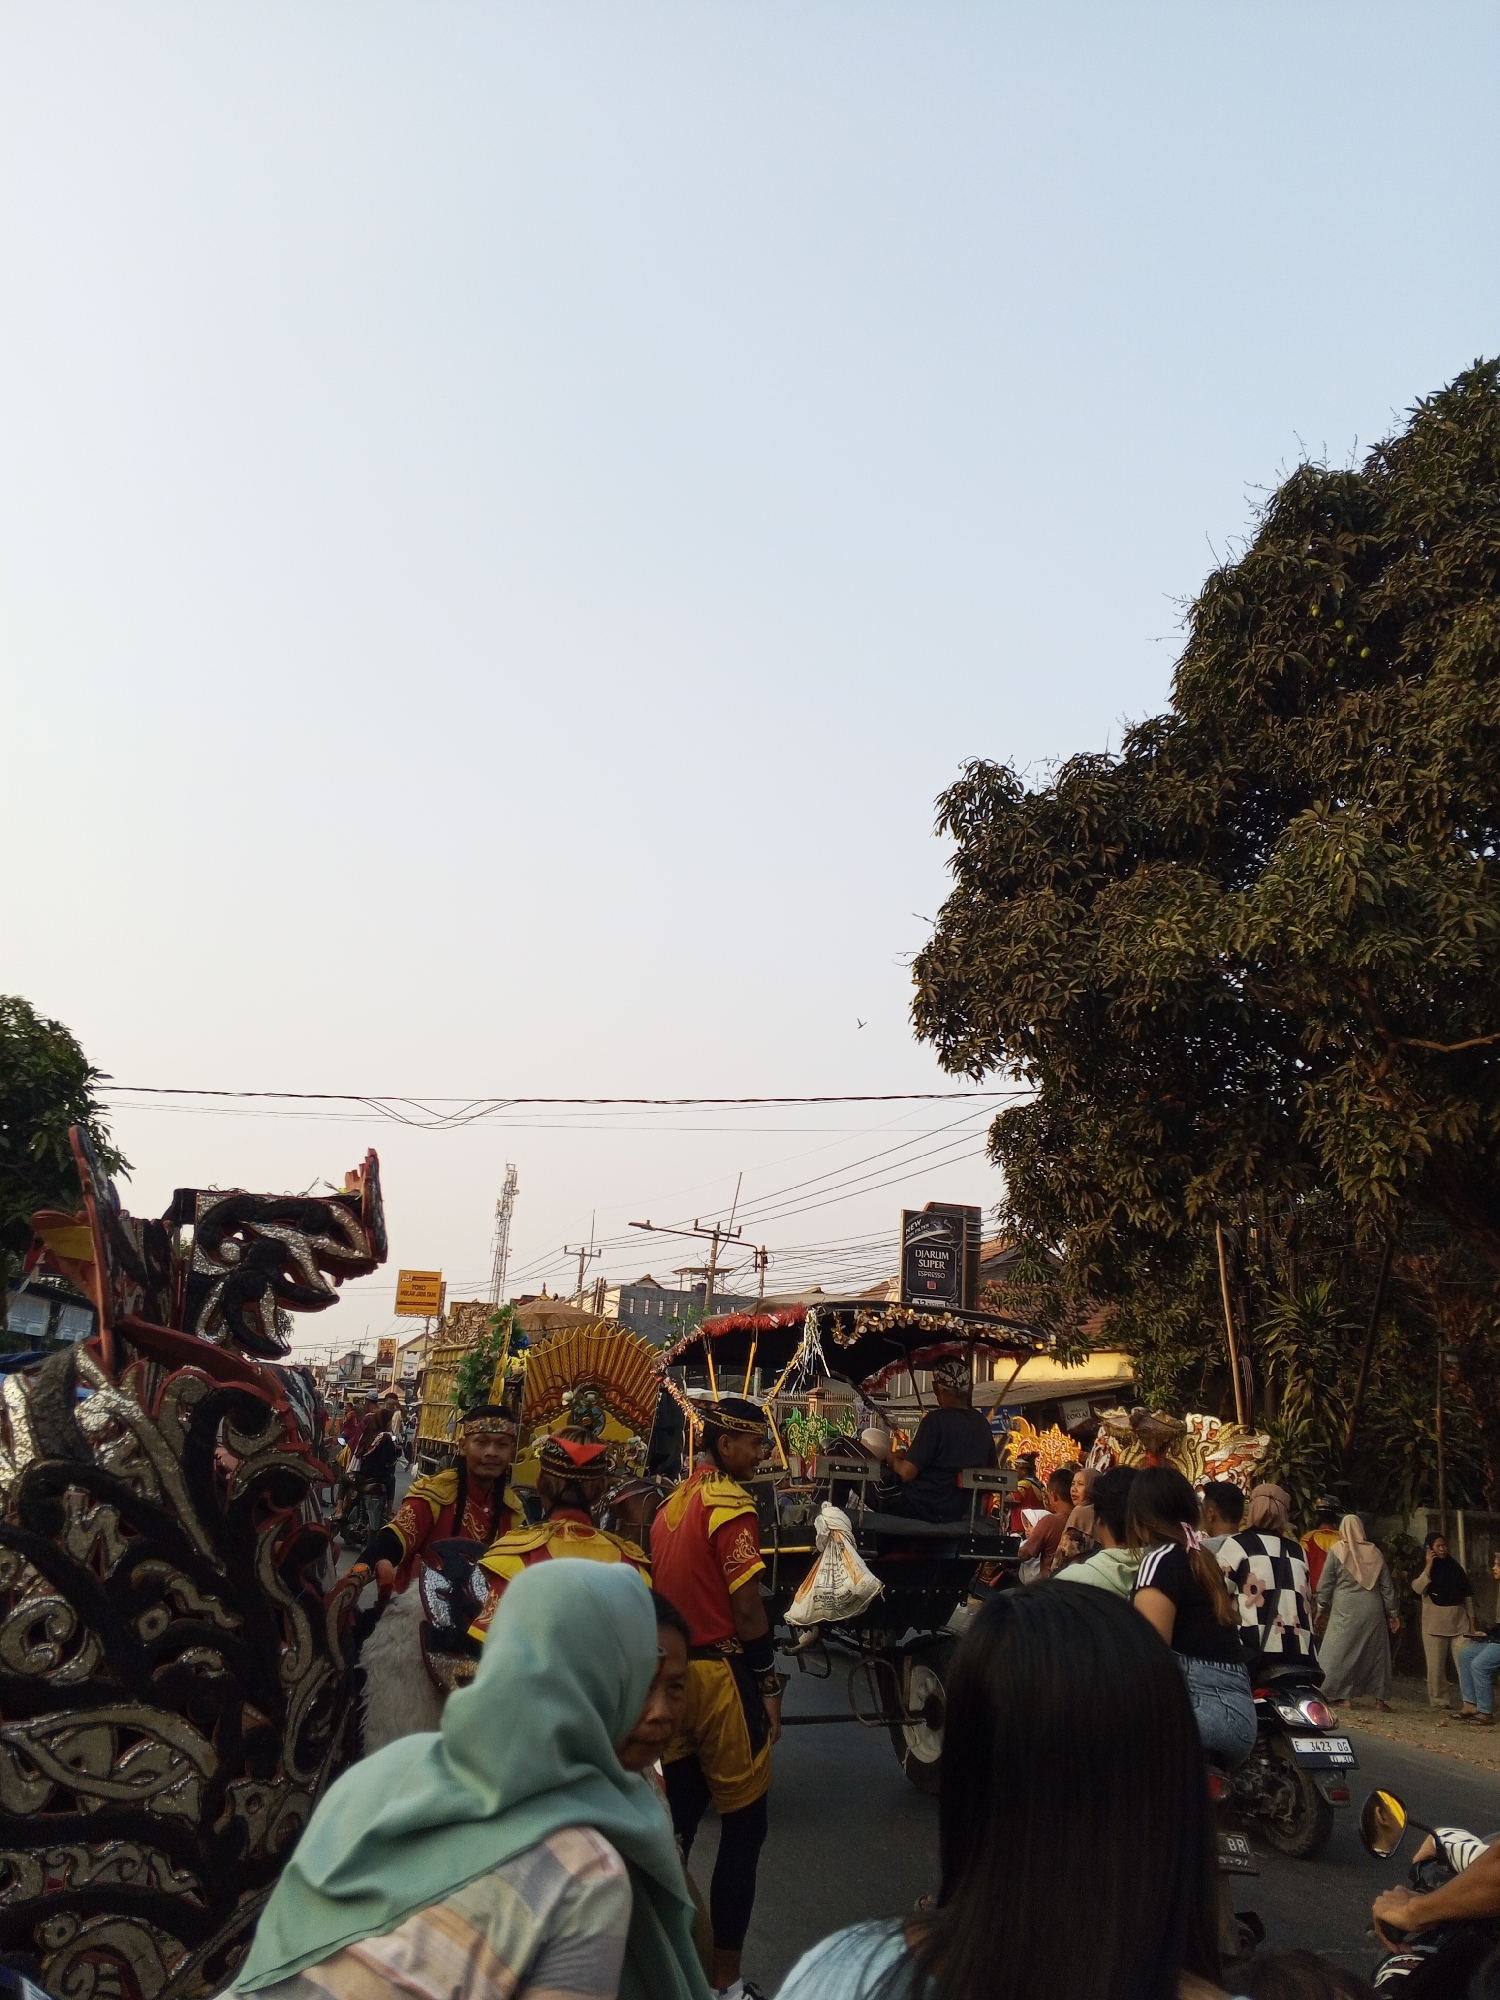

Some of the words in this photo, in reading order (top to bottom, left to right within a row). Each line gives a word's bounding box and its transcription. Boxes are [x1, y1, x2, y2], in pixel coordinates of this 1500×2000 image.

[905, 1219, 922, 1234] NEW
[915, 1249, 949, 1261] DJARUM
[918, 1259, 945, 1270] SUPER
[917, 1270, 946, 1279] ESPRESSO
[1066, 1411, 1089, 1420] COKLAT
[1294, 1741, 1302, 1752] E
[1309, 1741, 1332, 1752] 3423
